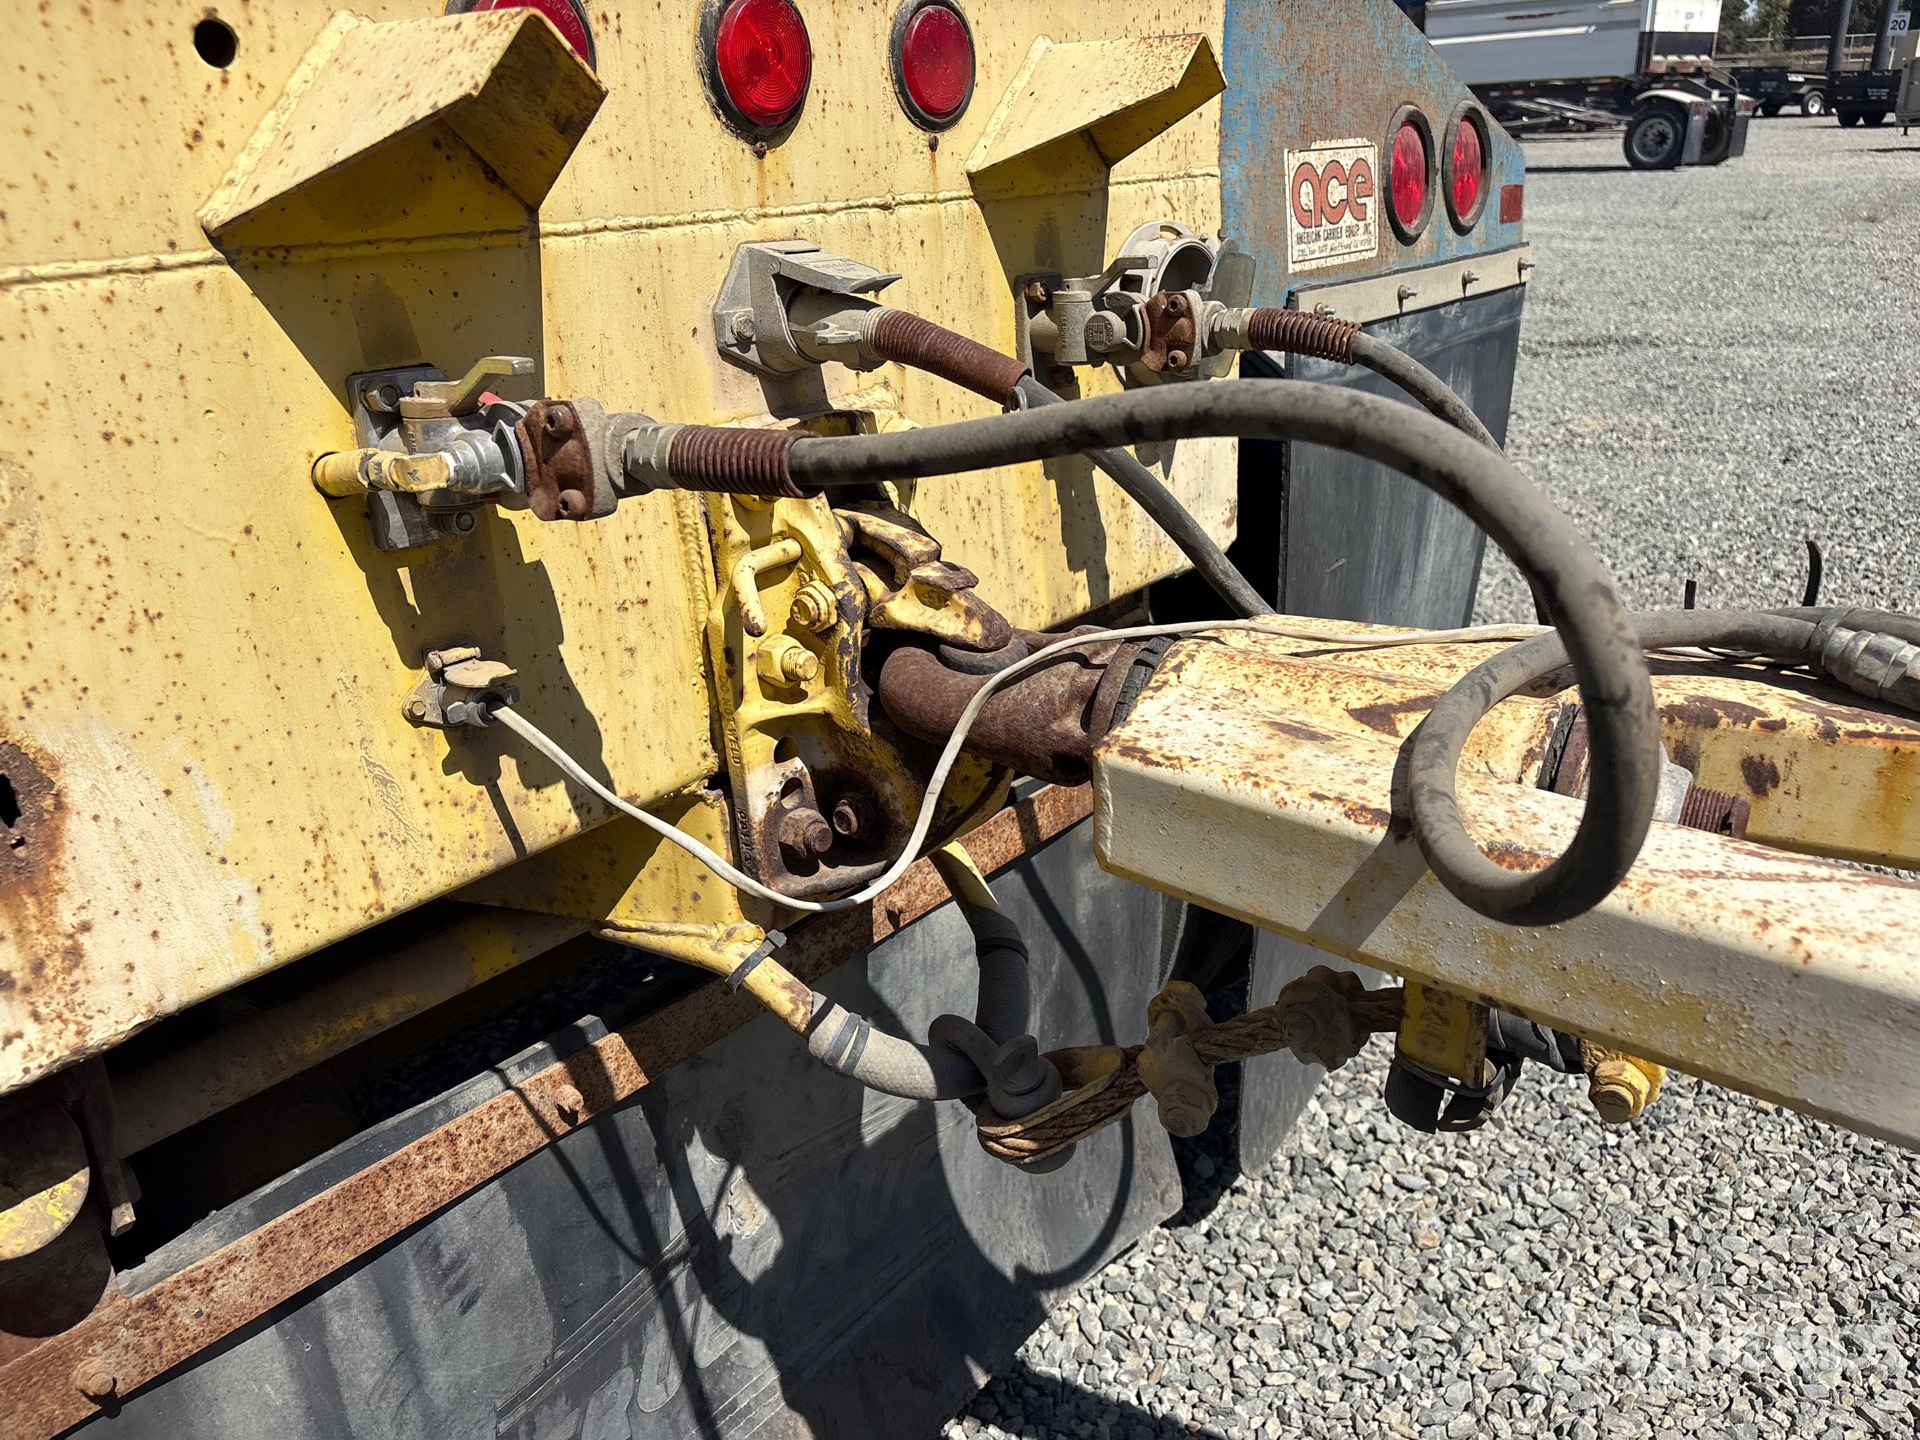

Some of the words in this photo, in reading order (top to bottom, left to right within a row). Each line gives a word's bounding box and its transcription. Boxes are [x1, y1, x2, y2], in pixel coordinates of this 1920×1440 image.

[1890, 19, 1906, 31] 20
[1292, 158, 1373, 228] ace
[1296, 228, 1321, 245] AMERICAN
[1323, 225, 1343, 241] CARRIER
[718, 674, 730, 694] DO
[726, 728, 742, 767] WELD
